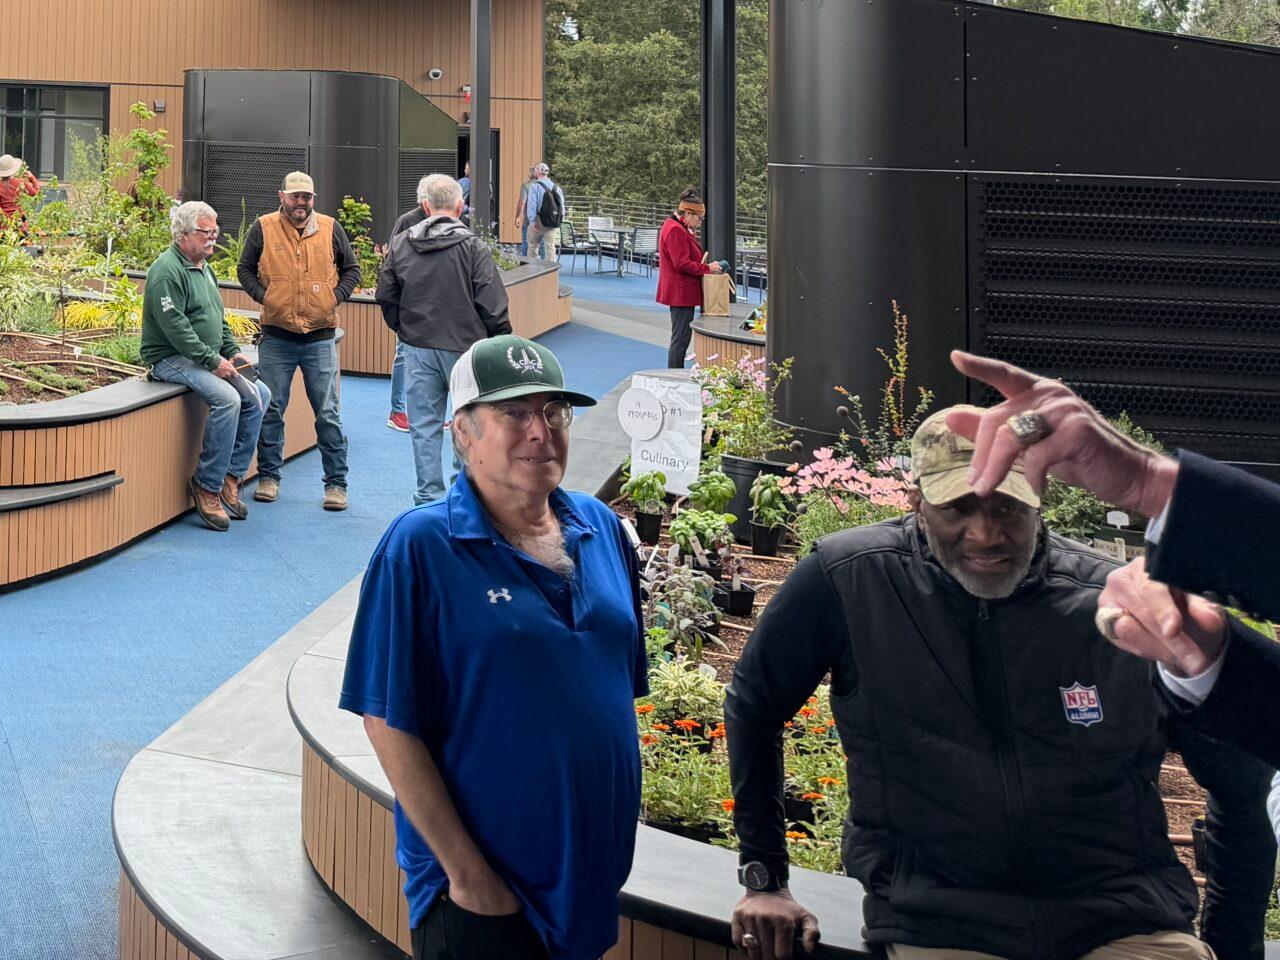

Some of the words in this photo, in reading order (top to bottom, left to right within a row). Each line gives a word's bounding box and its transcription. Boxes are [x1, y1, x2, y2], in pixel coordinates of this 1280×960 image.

[670, 407, 682, 417] #1
[640, 449, 689, 472] Culinary
[1066, 691, 1096, 707] NFL
[1070, 711, 1100, 721] ALUMNI
